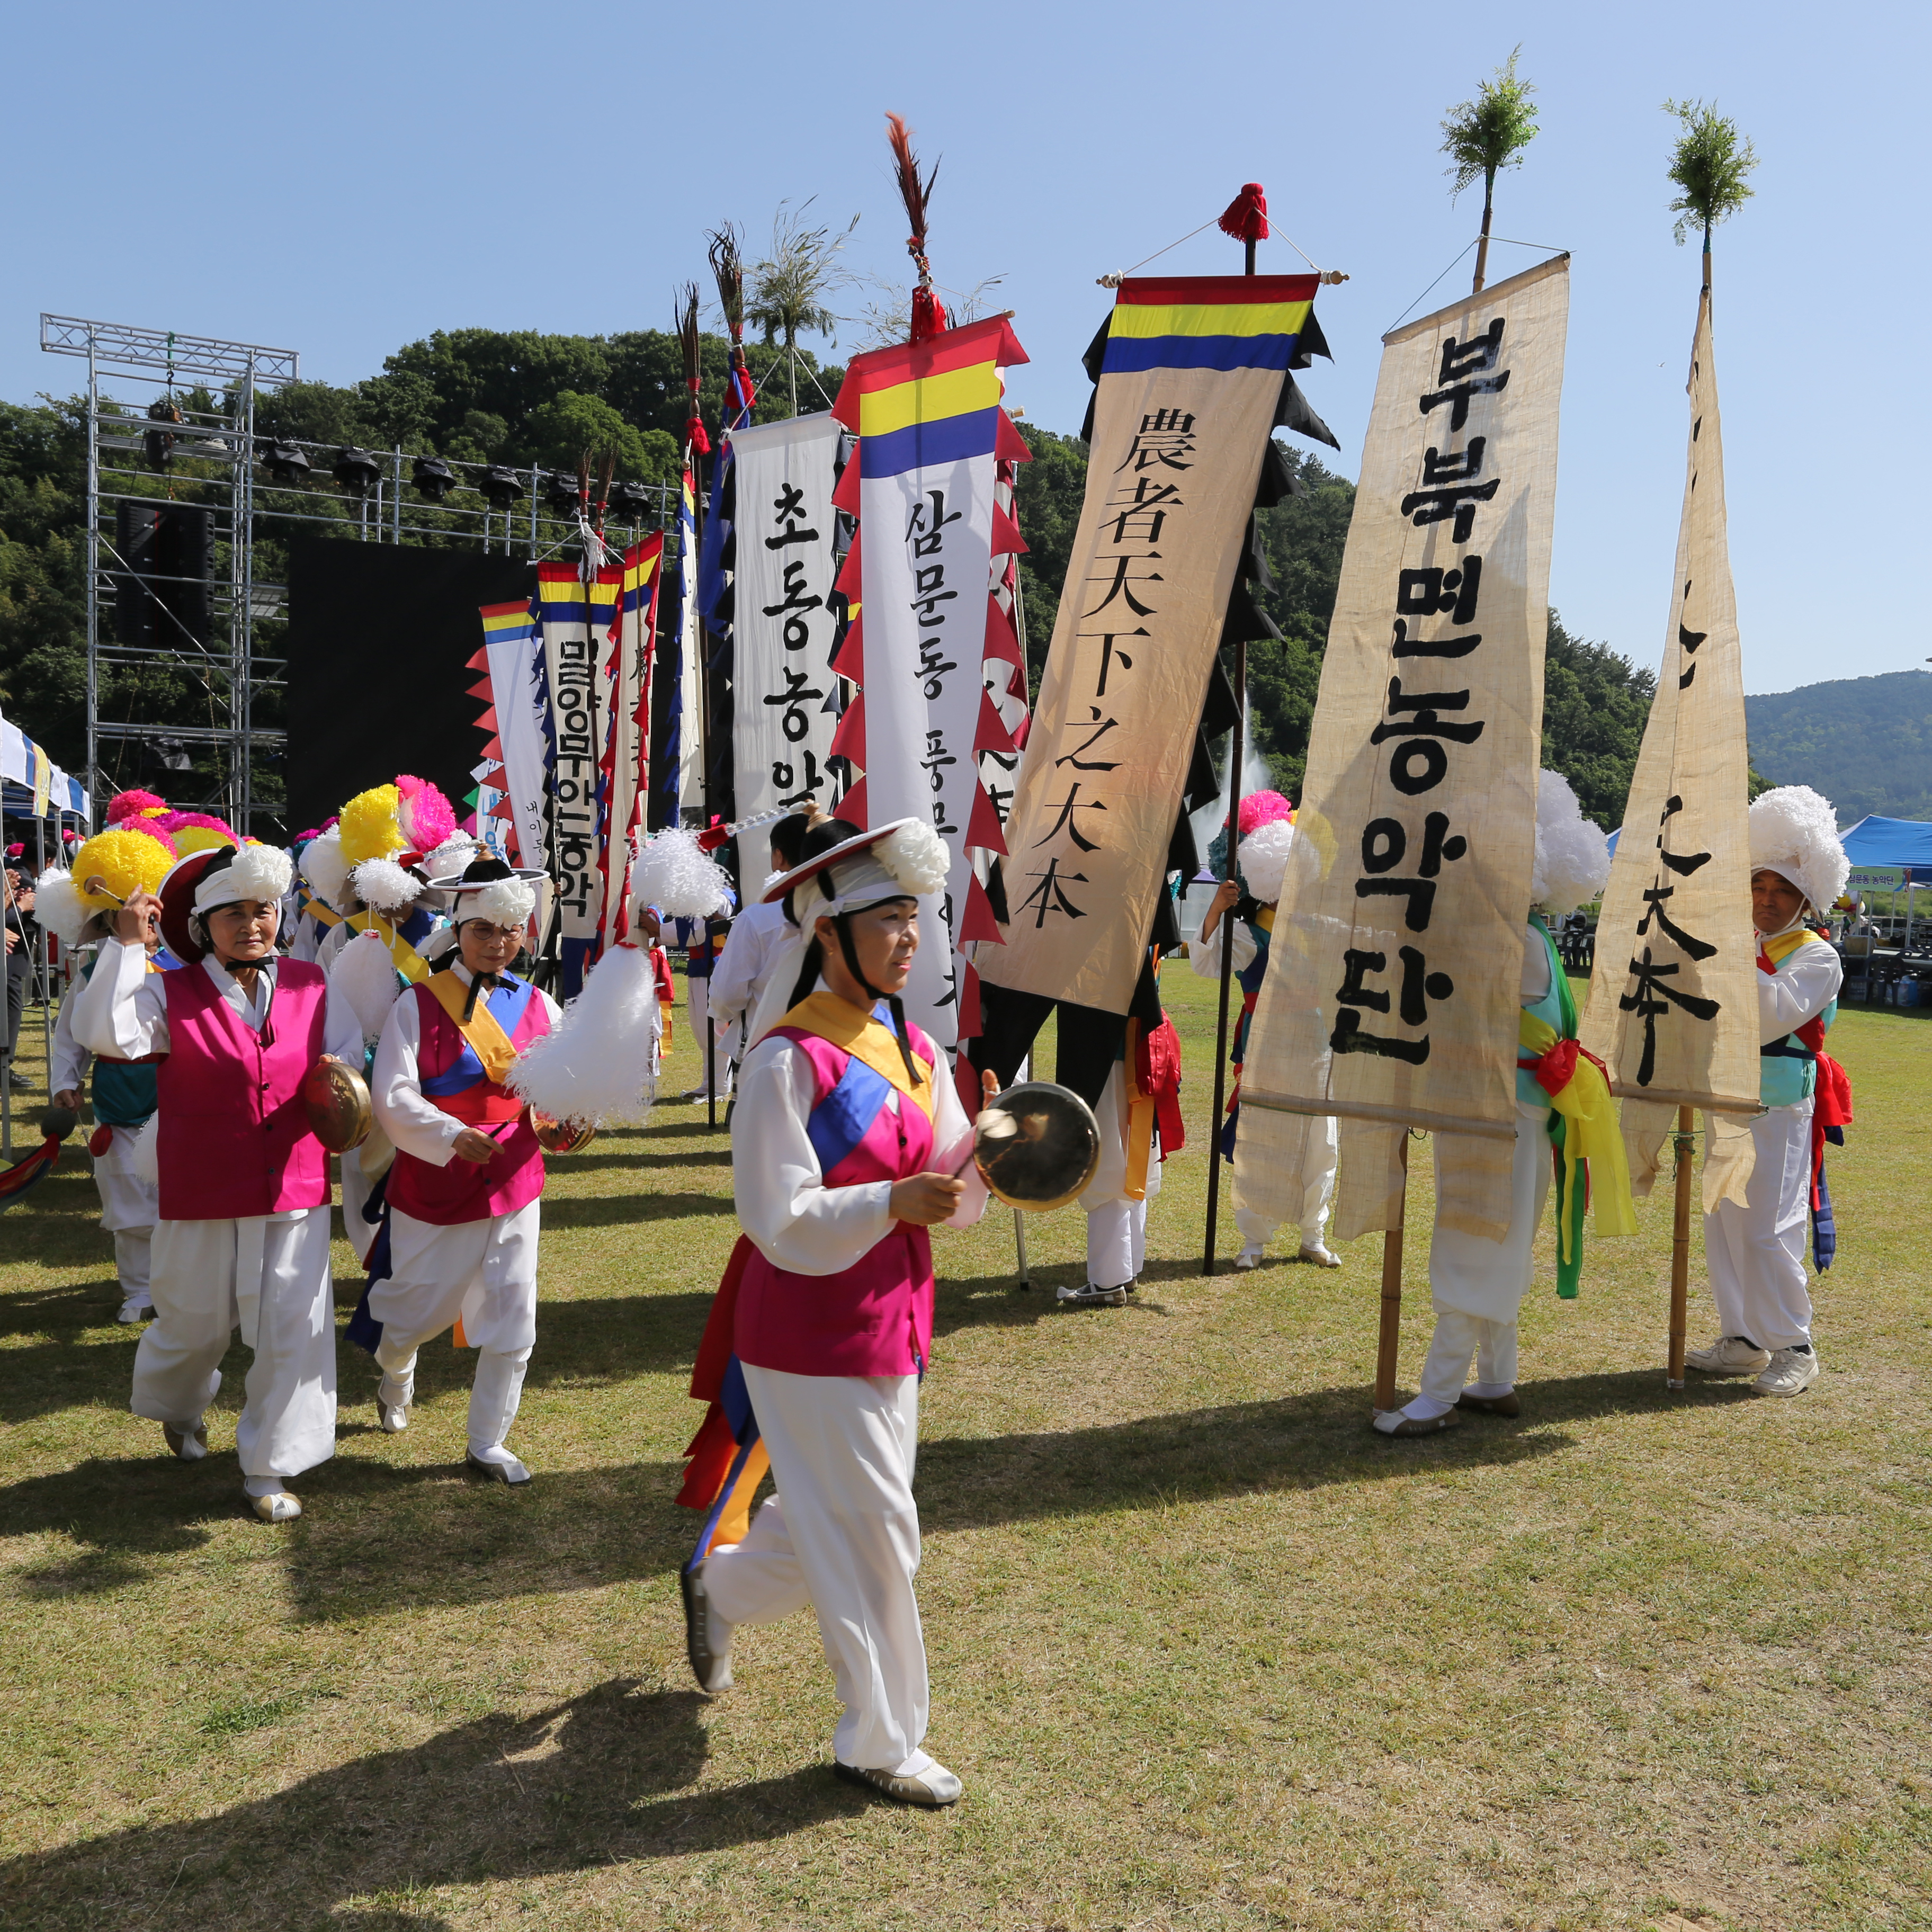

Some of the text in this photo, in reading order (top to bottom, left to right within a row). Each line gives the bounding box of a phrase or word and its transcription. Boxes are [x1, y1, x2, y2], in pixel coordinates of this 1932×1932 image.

[905, 490, 962, 700] 삼문동
[1015, 408, 1197, 929] 農者天下之大本
[1849, 874, 1894, 885] 삼문동 농악단
